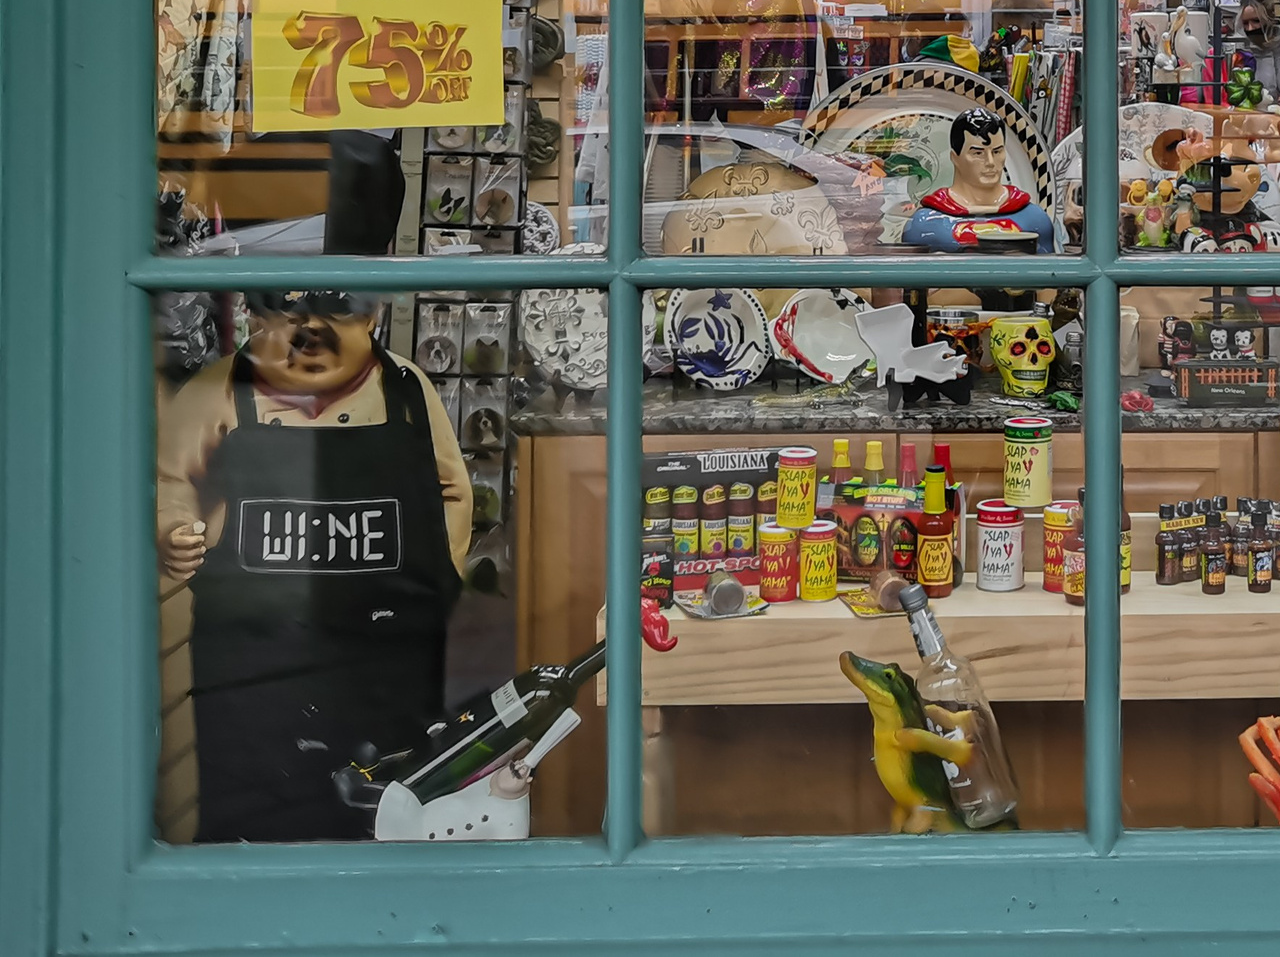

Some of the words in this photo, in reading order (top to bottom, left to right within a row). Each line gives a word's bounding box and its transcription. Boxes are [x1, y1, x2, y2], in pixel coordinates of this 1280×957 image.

[424, 76, 473, 104] OFF
[582, 331, 607, 343] Eve
[701, 453, 767, 472] LOUISIANA
[1011, 461, 1021, 474] YA
[786, 486, 798, 498] YA
[1165, 520, 1183, 529] MADE
[1192, 517, 1204, 525] NEW
[932, 554, 939, 562] YA
[990, 547, 1001, 558] YA
[1047, 547, 1056, 558] YA
[678, 559, 719, 575] HOT
[767, 560, 778, 572] YA
[813, 560, 825, 572] YA
